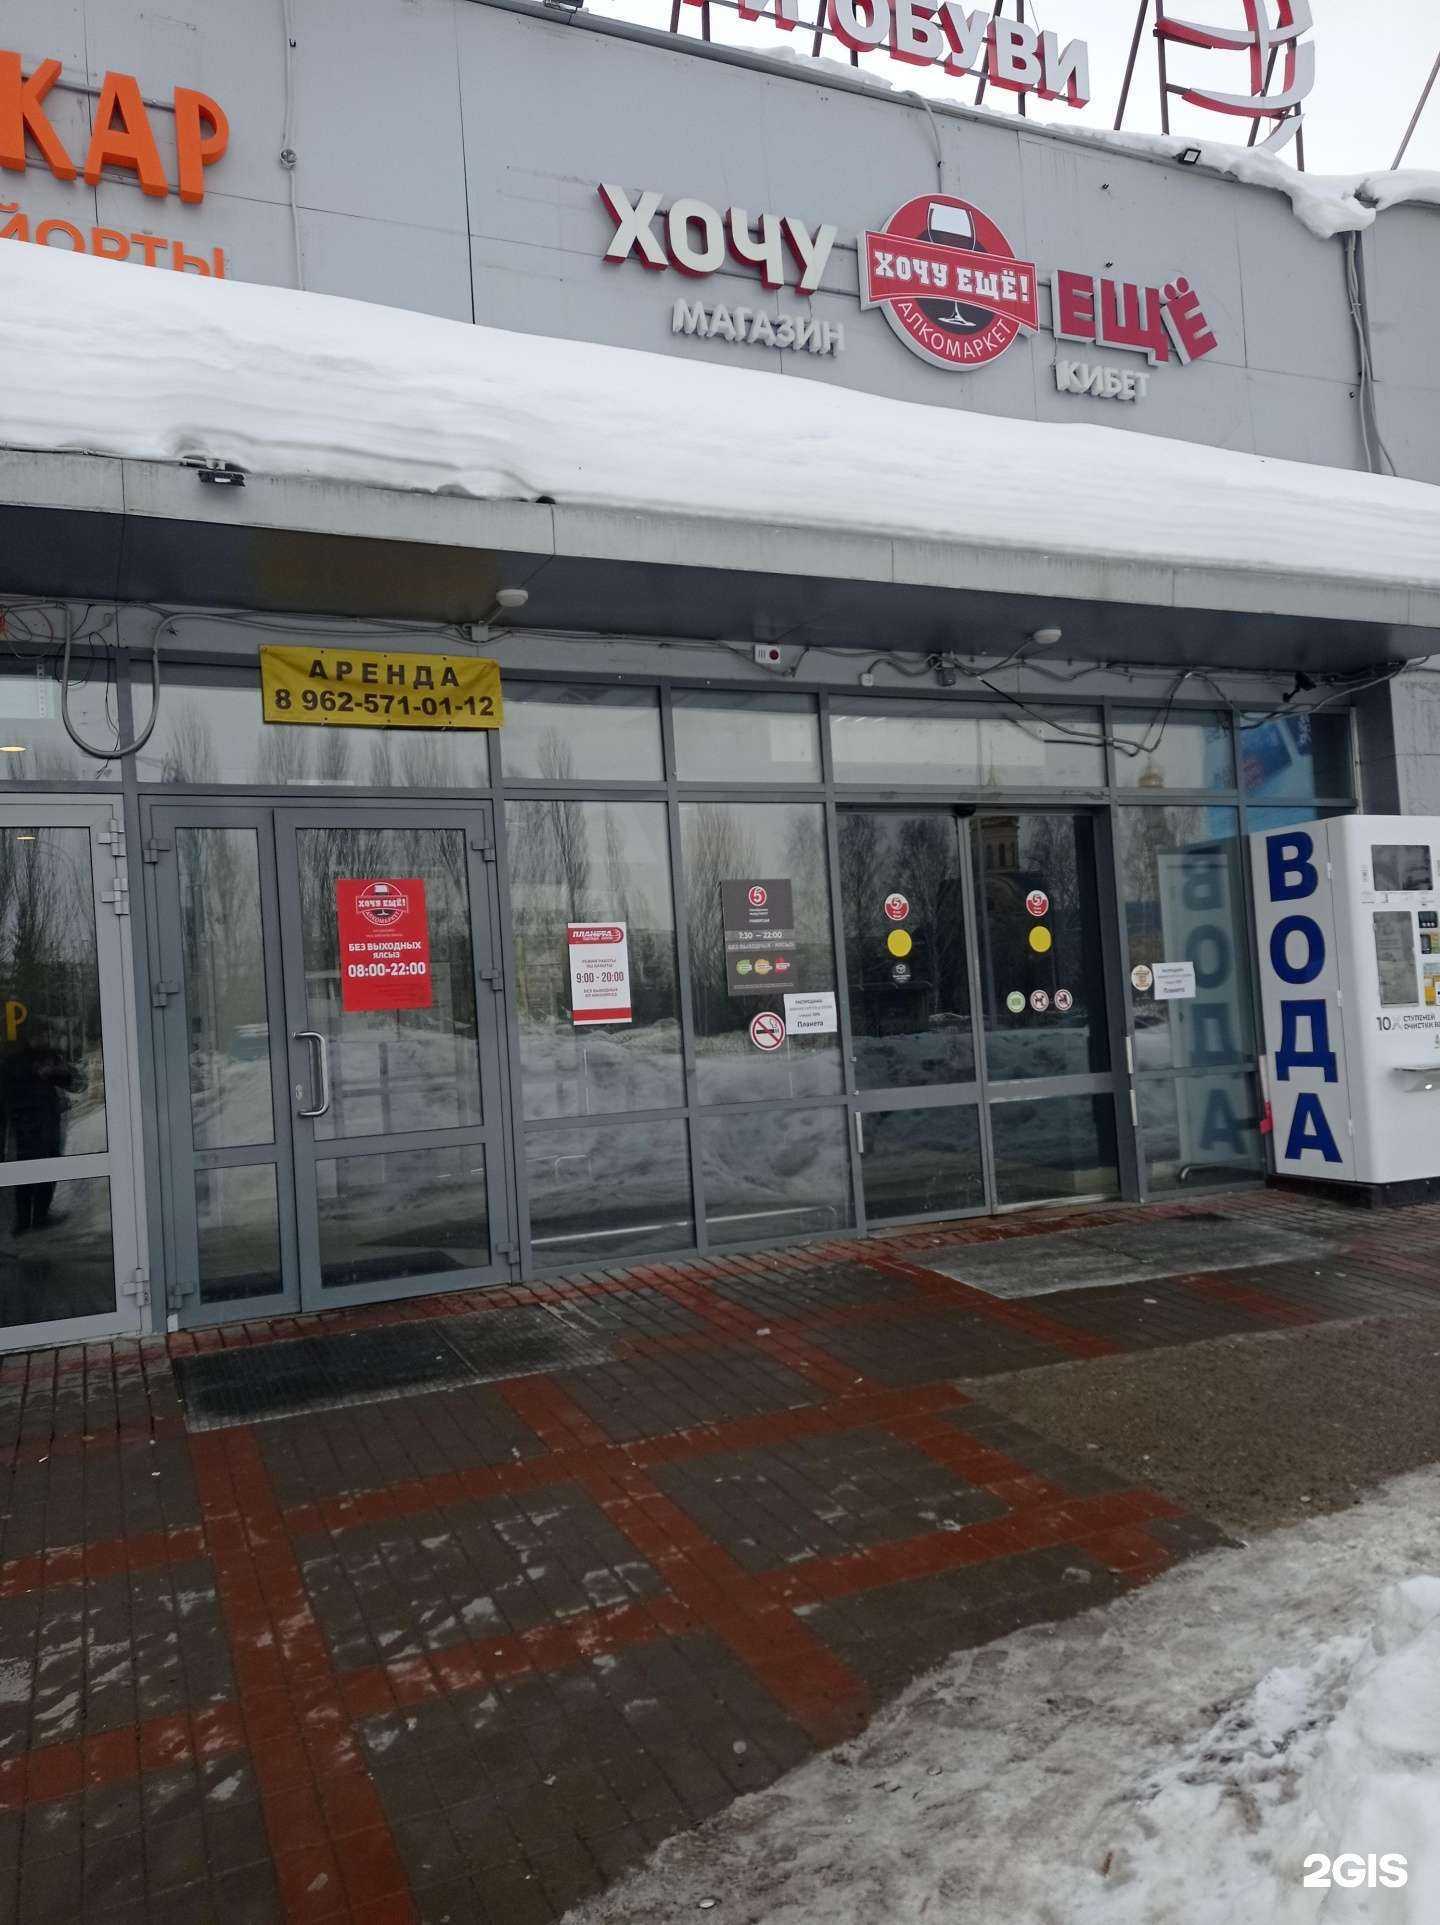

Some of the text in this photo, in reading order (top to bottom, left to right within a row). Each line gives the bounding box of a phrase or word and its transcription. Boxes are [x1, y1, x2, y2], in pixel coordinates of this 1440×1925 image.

[827, 0, 1090, 109] ОБУВИ
[0, 50, 230, 204] КАР
[597, 182, 838, 297] ХОЧУ
[874, 251, 1028, 302] ХОЧУ ЕЩЁ!
[672, 299, 844, 356] МАГАЗИН
[898, 300, 1012, 359] АЛКОМАРКЕТ
[1052, 269, 1218, 367] ЕЩЁ
[1055, 361, 1150, 401] КИБЕТ
[275, 688, 494, 716] 8 962-571-01-12
[308, 660, 460, 690] АРЕНДА
[348, 962, 426, 977] 08:00-22:00
[349, 942, 421, 951] БЕЗ ВЫХОДНЫХ
[576, 972, 594, 983] 9:00
[601, 971, 625, 982] 20:00
[1265, 831, 1344, 1164] ВОДА
